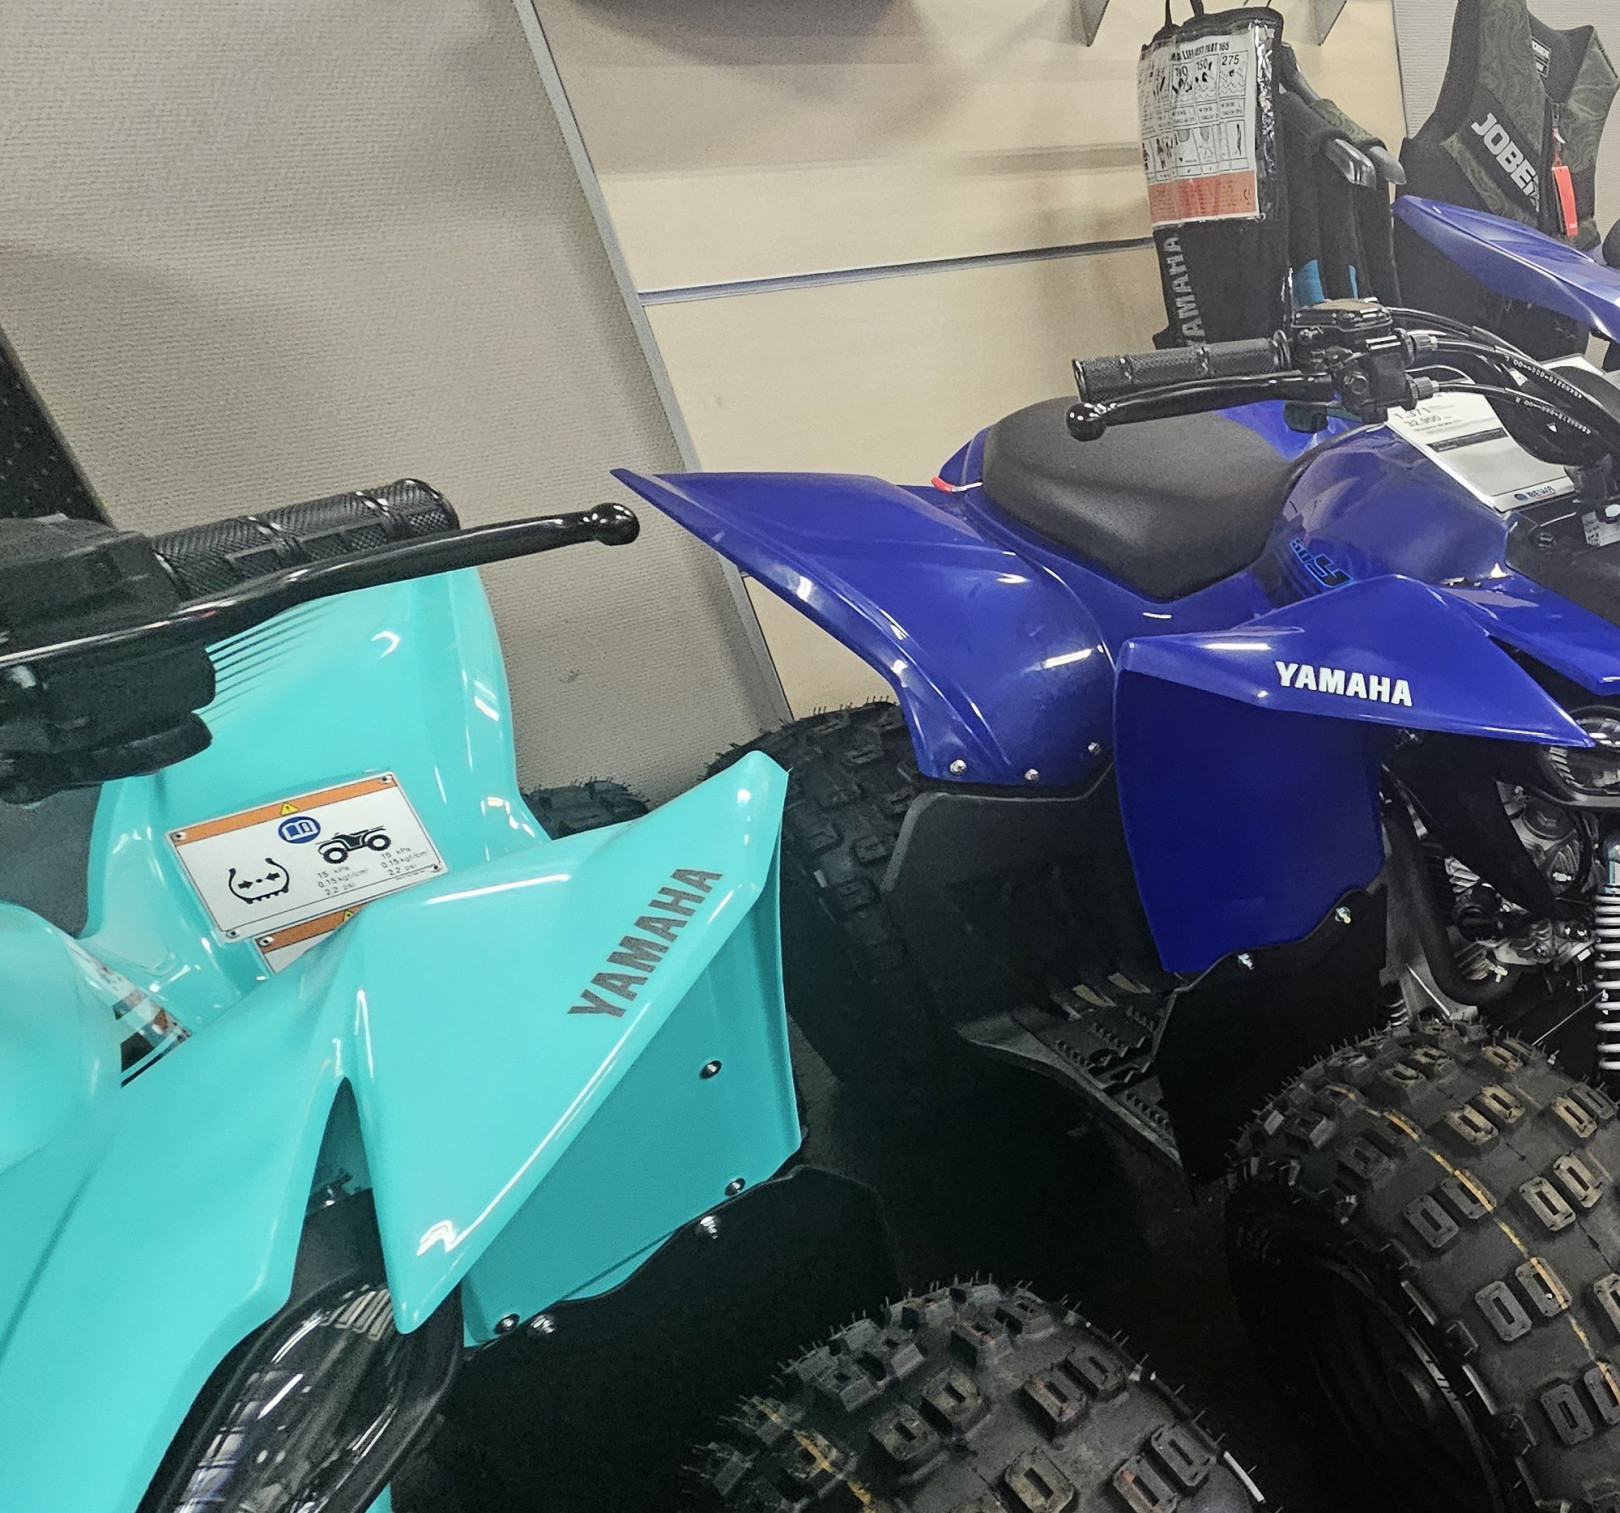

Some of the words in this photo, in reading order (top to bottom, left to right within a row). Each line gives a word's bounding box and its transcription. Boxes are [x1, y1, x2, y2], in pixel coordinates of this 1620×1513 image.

[1222, 55, 1240, 66] 275
[1289, 537, 1314, 564] 50
[1275, 661, 1413, 707] YAMAHA
[317, 871, 329, 879] 15
[567, 868, 723, 1018] YAMAHA
